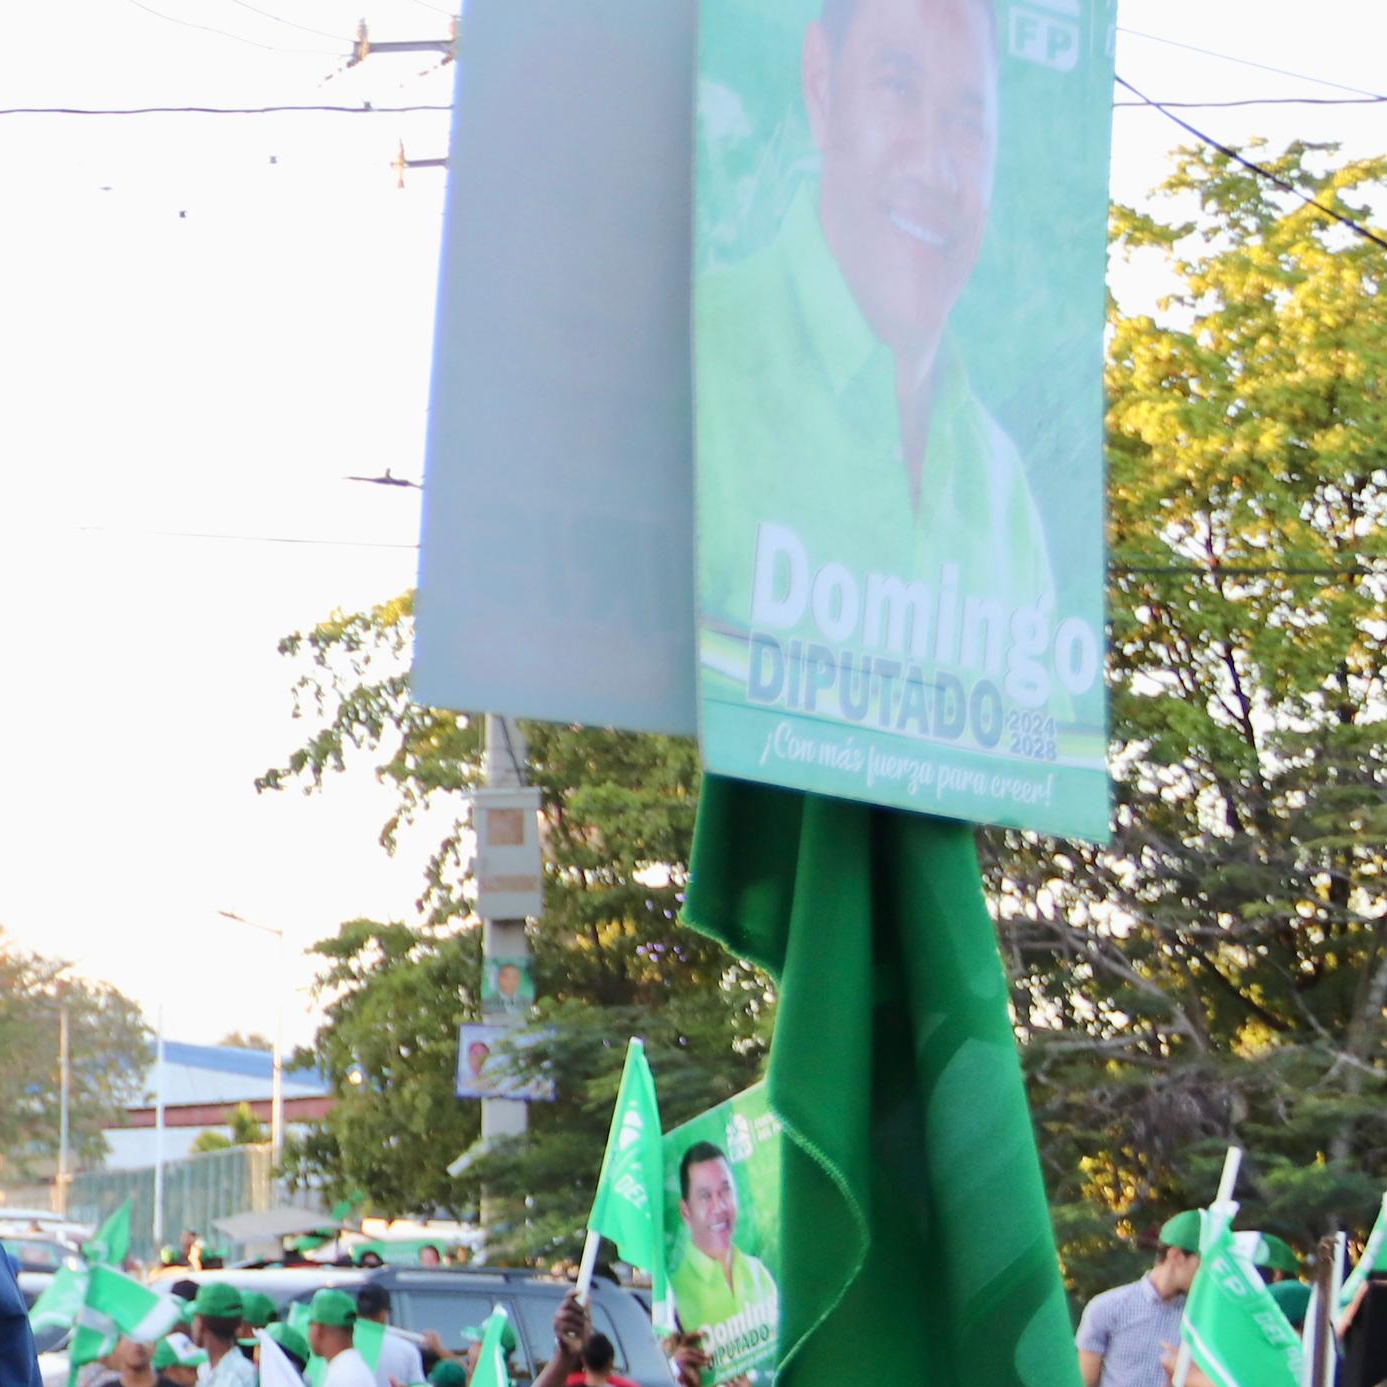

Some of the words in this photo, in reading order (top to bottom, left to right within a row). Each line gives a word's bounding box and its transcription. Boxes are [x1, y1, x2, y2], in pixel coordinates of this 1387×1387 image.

[1013, 14, 1074, 61] FP
[749, 521, 1099, 709] Domingo
[746, 631, 1005, 751] DIPUTADO
[1006, 710, 1057, 736] 2024
[1008, 732, 1058, 761] 2028
[815, 738, 865, 771] más
[866, 745, 935, 797] fuerza
[935, 768, 988, 800] para
[989, 772, 1055, 807] creer!
